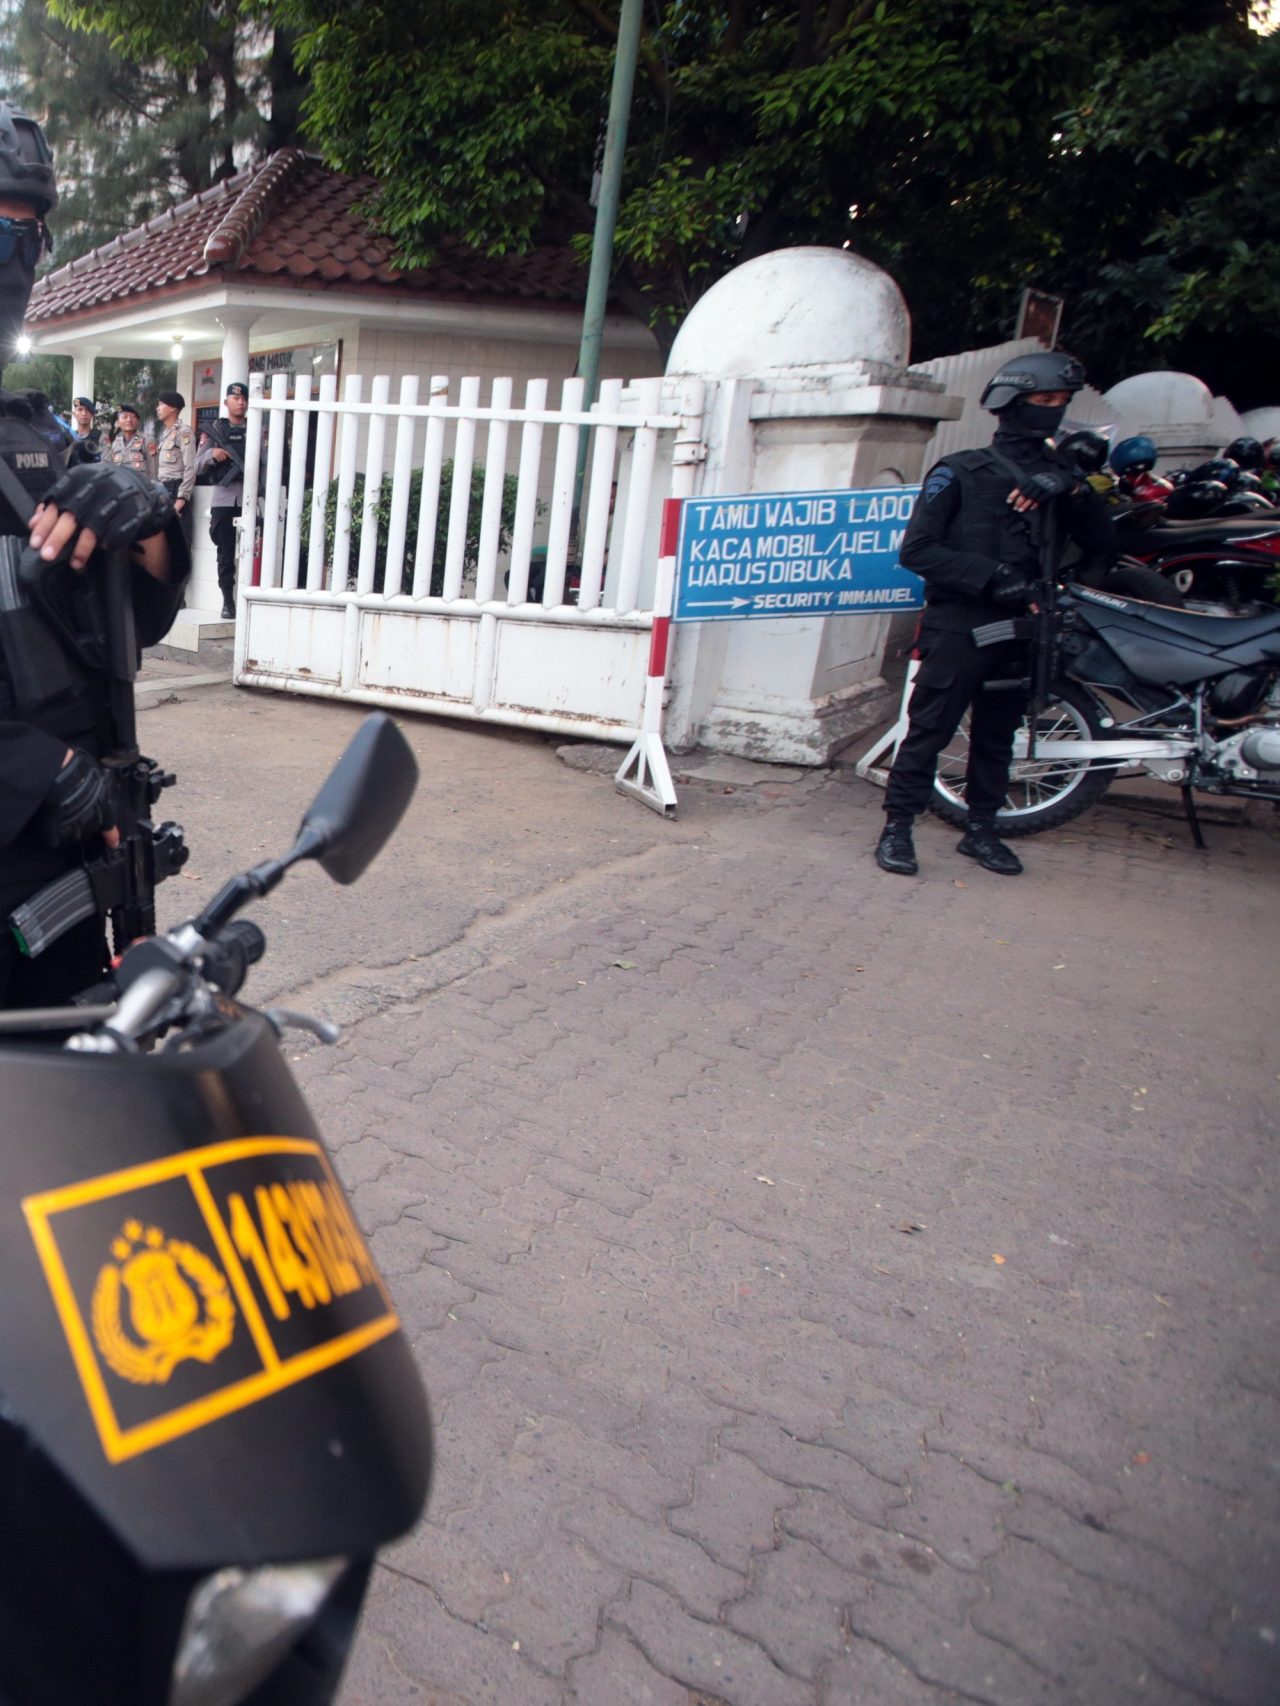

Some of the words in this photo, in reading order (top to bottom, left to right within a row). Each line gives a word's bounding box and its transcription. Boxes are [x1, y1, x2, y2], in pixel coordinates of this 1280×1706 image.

[16, 453, 48, 469] POLISI
[695, 502, 760, 531] TAMU
[765, 498, 836, 527] WAJIB
[848, 494, 920, 524] LAPO
[690, 536, 749, 562] KACA
[687, 562, 766, 588] HARUS
[767, 558, 853, 585] DIBUKA
[752, 590, 833, 610] SECURITY
[838, 587, 916, 606] IMMANUEL
